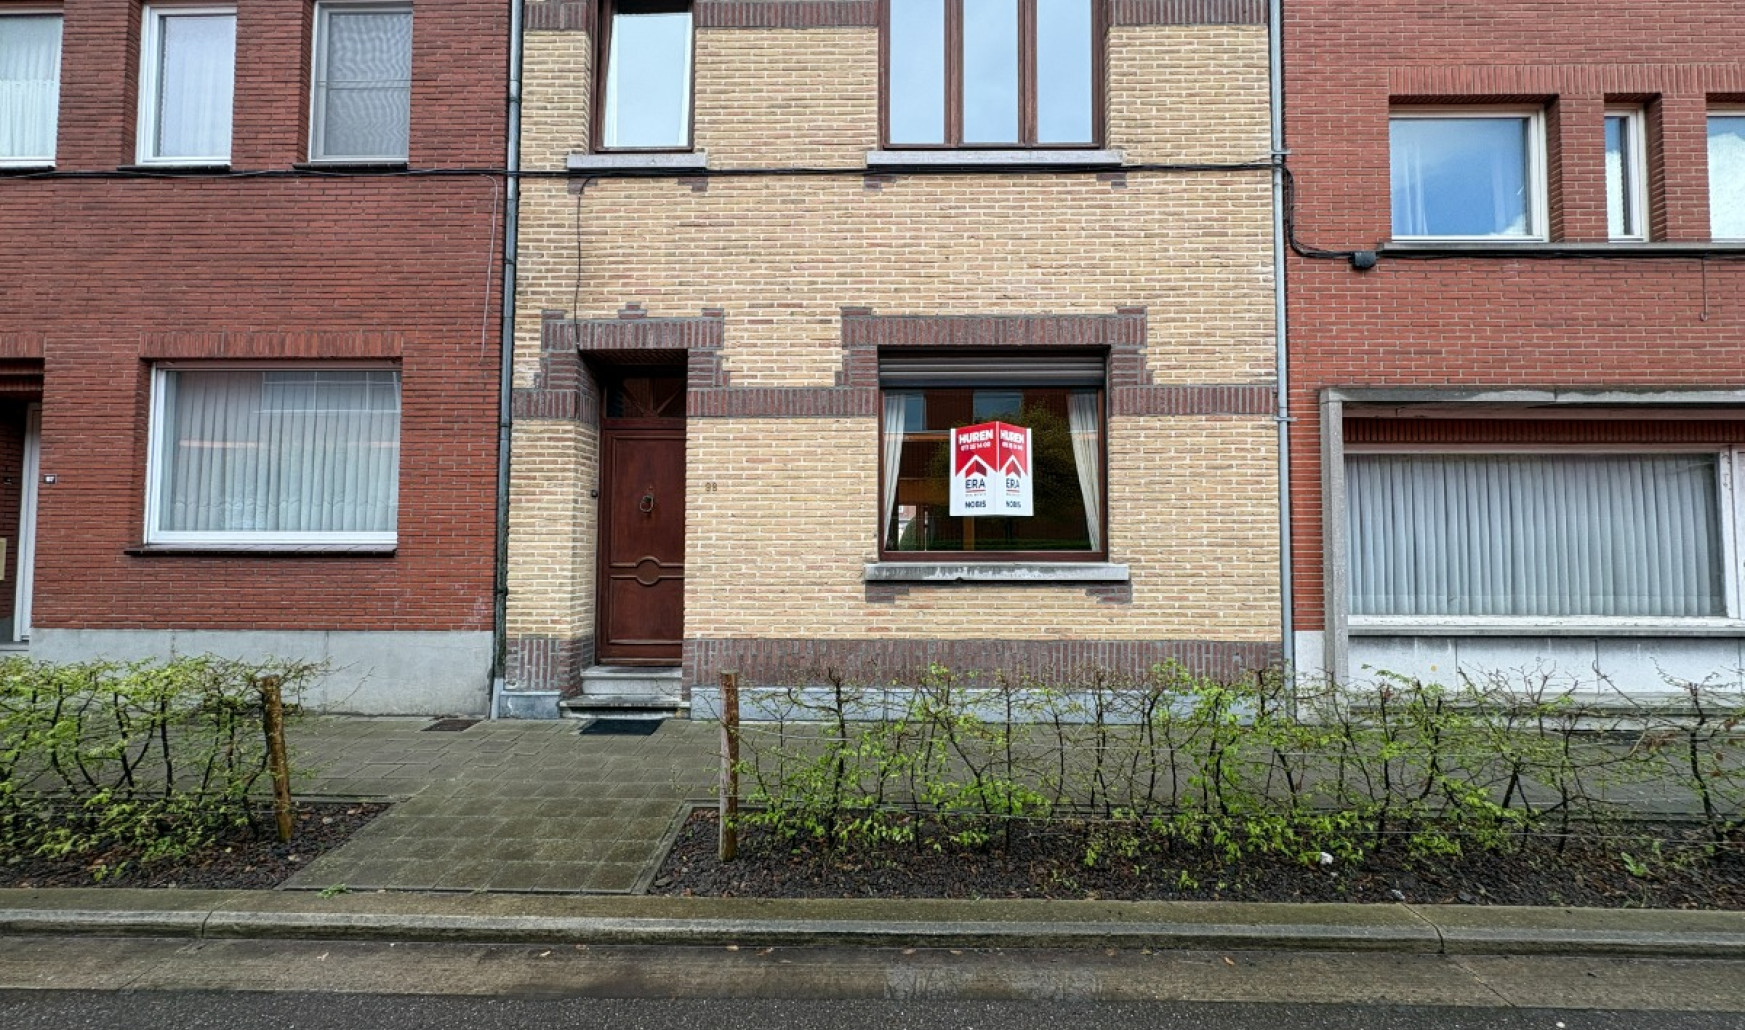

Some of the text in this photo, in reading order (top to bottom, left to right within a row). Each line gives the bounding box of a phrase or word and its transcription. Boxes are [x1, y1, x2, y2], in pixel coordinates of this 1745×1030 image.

[959, 429, 994, 445] HUREN
[1000, 429, 1025, 443] HUREN
[965, 478, 986, 489] ERA
[1006, 478, 1020, 489] ERA
[965, 500, 987, 509] NOBIS
